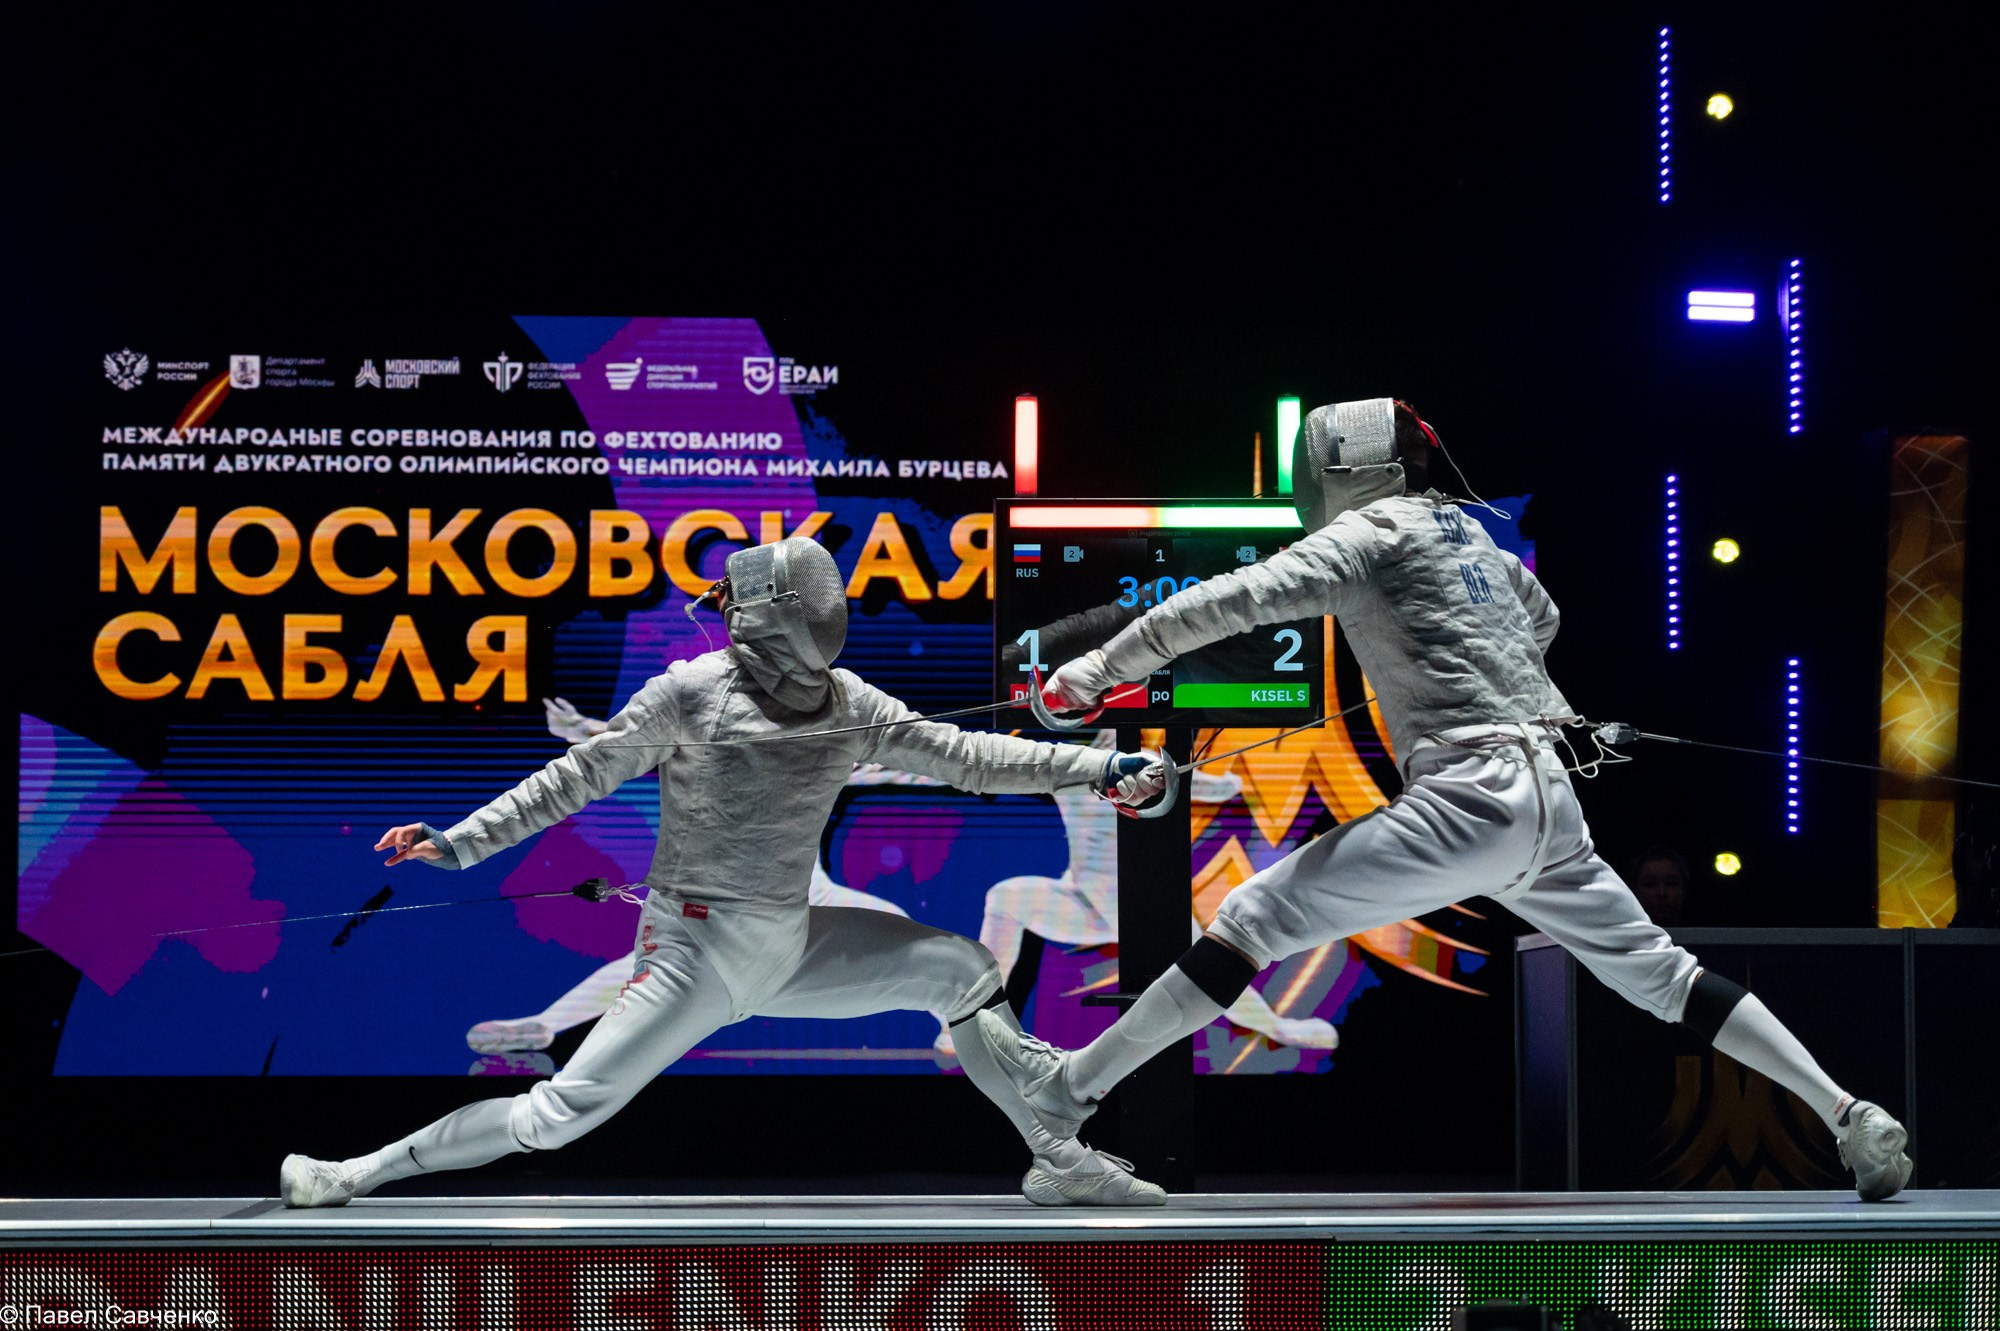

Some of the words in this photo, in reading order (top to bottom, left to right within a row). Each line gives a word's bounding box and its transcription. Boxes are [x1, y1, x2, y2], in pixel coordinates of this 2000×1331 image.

[385, 356, 460, 374] МОСКОВСКИЙ
[157, 373, 197, 381] РОССИИ
[385, 374, 420, 389] СПОРТ
[779, 365, 839, 384] ЕРАИ
[102, 427, 342, 447] МЕЖДУНАРОДНЫЕ
[350, 429, 552, 449] СОРЕВНОВАНИЯ
[560, 431, 597, 448] ПО
[604, 431, 783, 450] ФЕХТОВАНИЮ
[102, 453, 206, 471] ПАМЯТИ
[213, 454, 392, 474] ДВУКРАТНОГО
[399, 452, 609, 476] ОЛИМПИЙСКОГО
[618, 456, 759, 477] ЧЕМПИОНА
[767, 458, 891, 478] МИХАИЛА
[898, 460, 1009, 481] БУРЦЕВА
[1155, 549, 1165, 562] 1
[1015, 568, 1039, 578] RUS
[93, 610, 528, 702] САБЛЯ
[1016, 629, 1049, 672] 1
[1273, 628, 1304, 672] 2
[1251, 690, 1293, 701] KISEL
[1297, 690, 1306, 701] S
